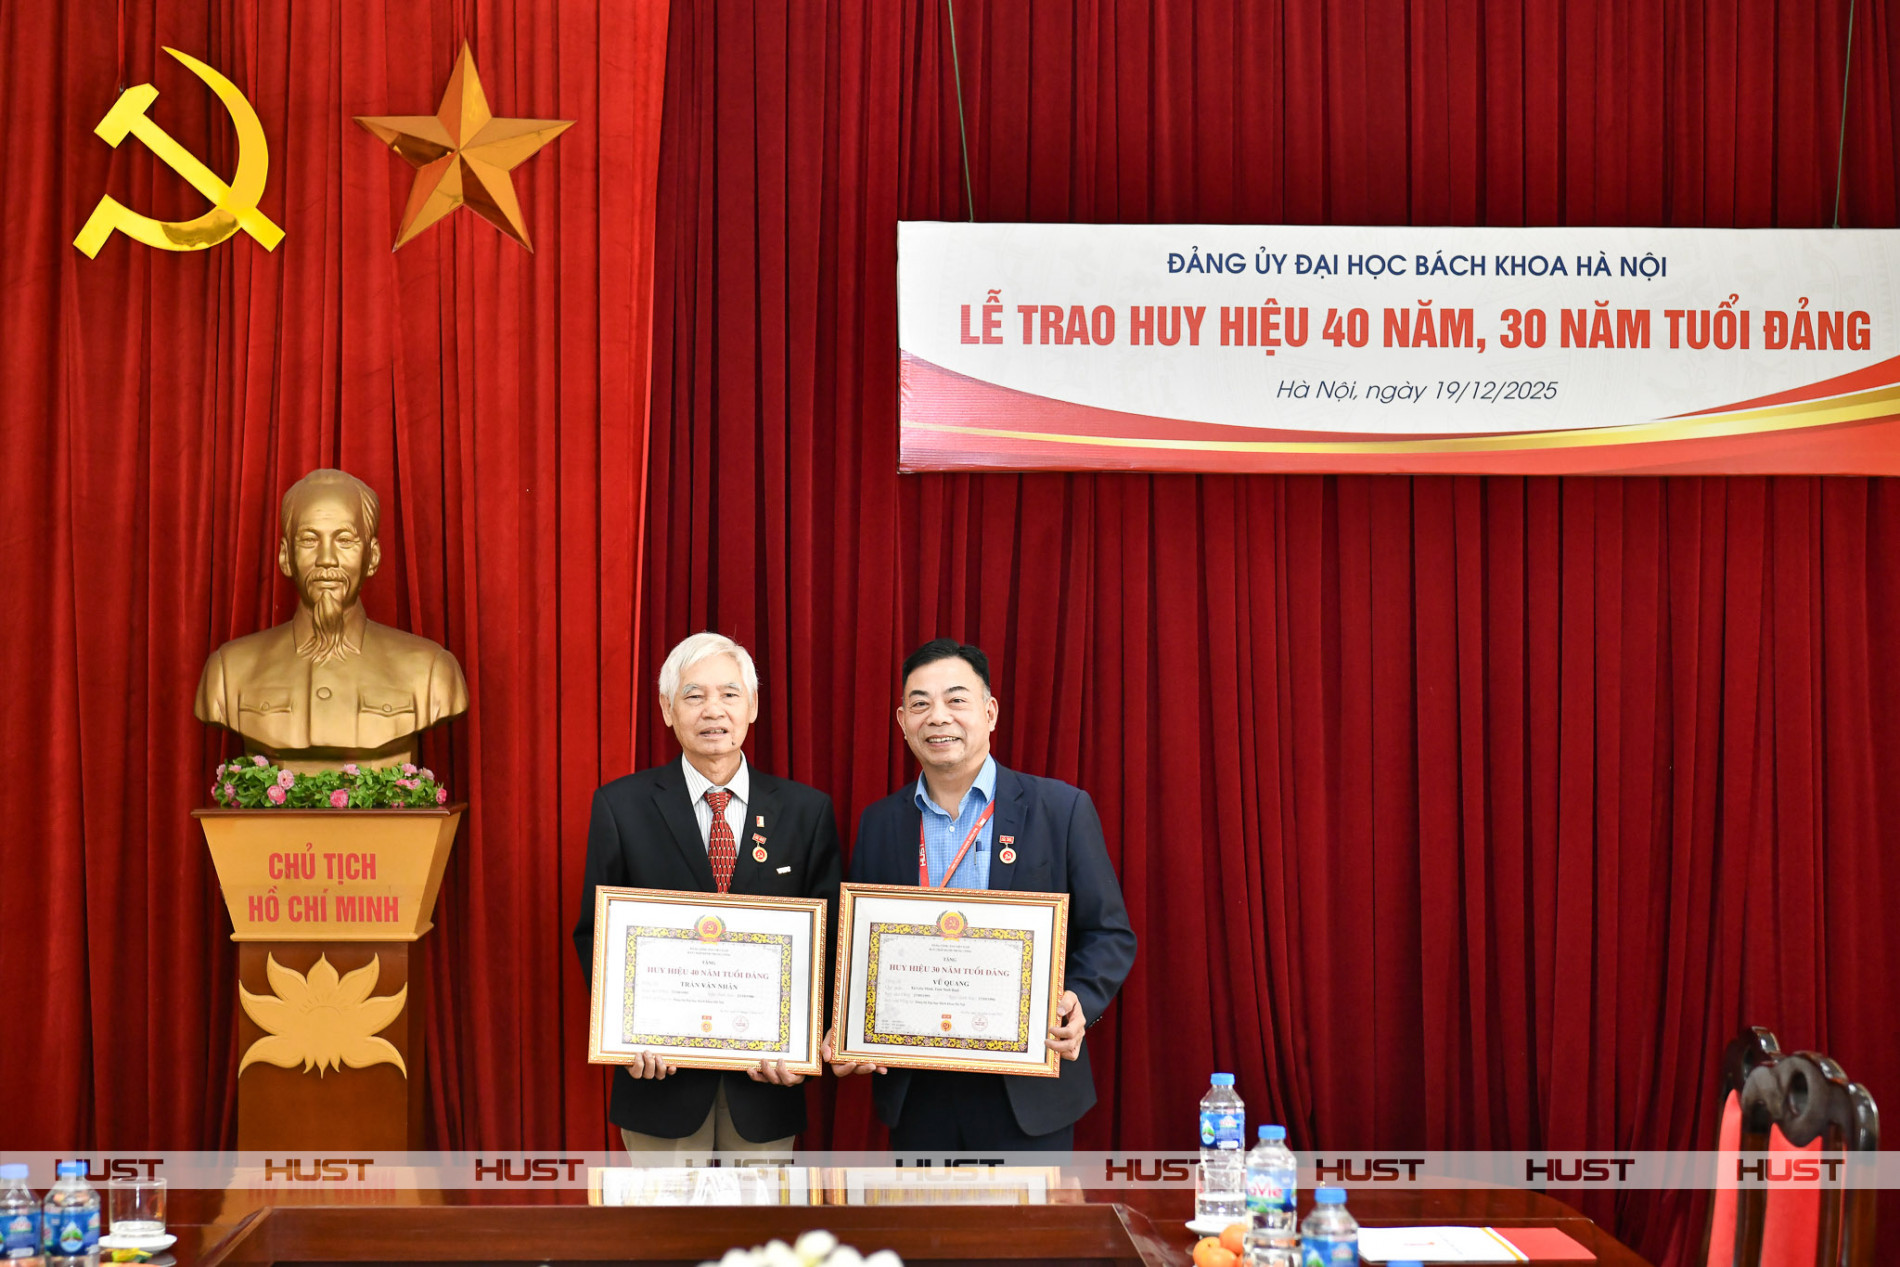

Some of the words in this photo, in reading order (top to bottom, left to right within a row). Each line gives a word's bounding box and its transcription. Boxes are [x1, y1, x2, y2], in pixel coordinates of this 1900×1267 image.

[1167, 246, 1246, 275] ĐẢNG
[1256, 246, 1288, 275] ỦY
[1295, 254, 1338, 281] ĐẠI
[1347, 254, 1407, 281] HỌC
[1416, 248, 1486, 277] BÁCH
[1495, 255, 1569, 277] KHOA
[1577, 249, 1613, 277] HÀ
[1621, 251, 1667, 283] NỘI
[961, 289, 1003, 345] LỄ
[1017, 305, 1115, 346] TRAO
[1130, 306, 1206, 346] HUY
[1220, 298, 1309, 356] HIỆU
[1322, 308, 1369, 348] 40
[1383, 299, 1486, 354] NĂM,
[1500, 309, 1546, 349] 30
[1560, 301, 1651, 349] NĂM
[1664, 293, 1750, 350] TUỔI
[1763, 296, 1871, 351] ĐẢNG
[1276, 380, 1311, 399] Hà
[1317, 380, 1358, 404] Nội,
[1365, 380, 1428, 405] ngày
[1436, 382, 1559, 404] 19/12/2025
[268, 842, 316, 880] CHỦ
[323, 852, 377, 886] TỊCH
[248, 885, 280, 923] HỒ
[288, 888, 328, 923] CHÍ
[335, 895, 399, 923] MINH
[647, 966, 666, 974] HUY
[701, 969, 721, 978] NĂM
[889, 964, 908, 972] HUY
[909, 964, 931, 975] HIỆU
[931, 966, 941, 974] 30
[942, 966, 962, 975] NĂM
[1246, 1182, 1283, 1198] aVie
